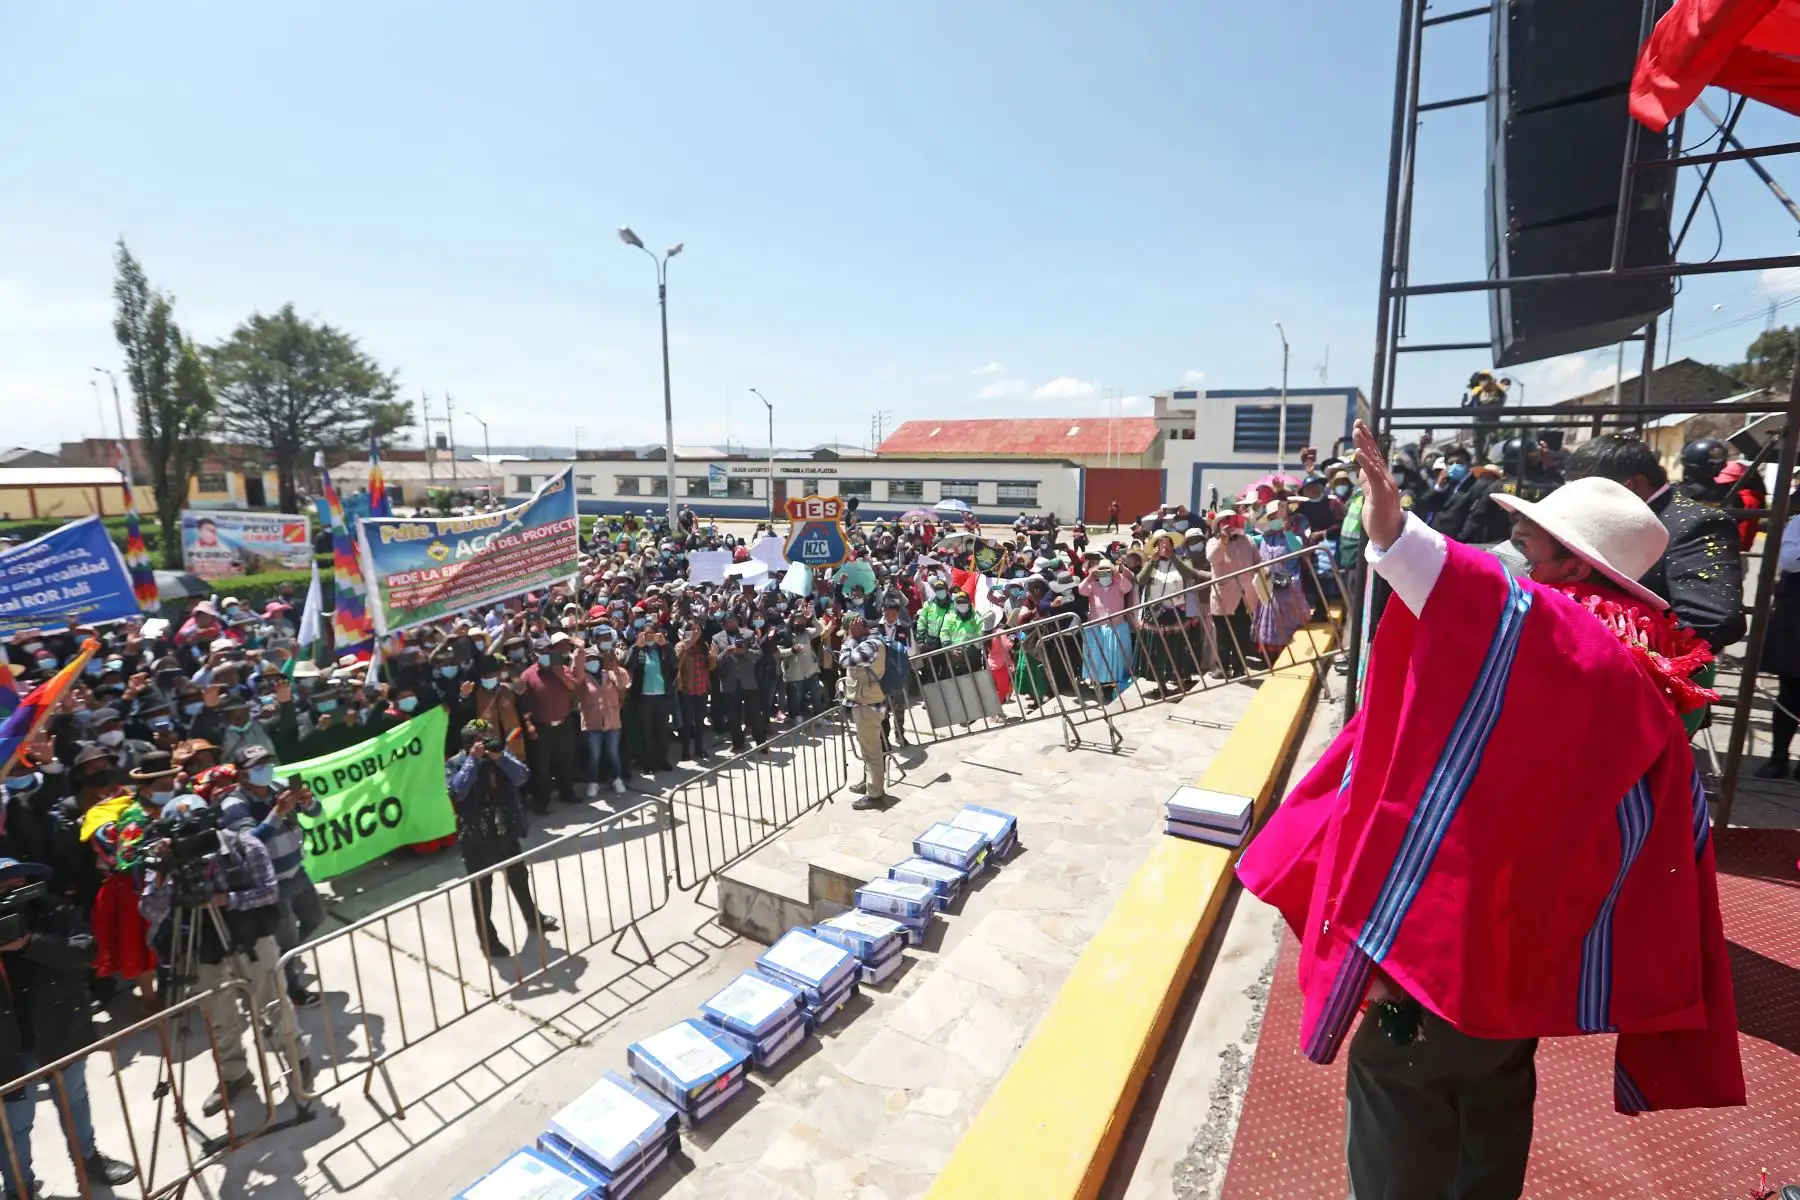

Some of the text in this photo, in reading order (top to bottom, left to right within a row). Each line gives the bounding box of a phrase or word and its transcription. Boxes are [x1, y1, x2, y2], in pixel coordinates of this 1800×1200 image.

[796, 503, 837, 518] IES
[44, 557, 110, 583] realidad
[388, 572, 419, 587] PIDE
[421, 569, 440, 581] LA
[498, 535, 520, 549] DEL
[21, 590, 61, 607] ROR
[62, 581, 91, 599] Juli
[304, 796, 403, 857] UNCO
